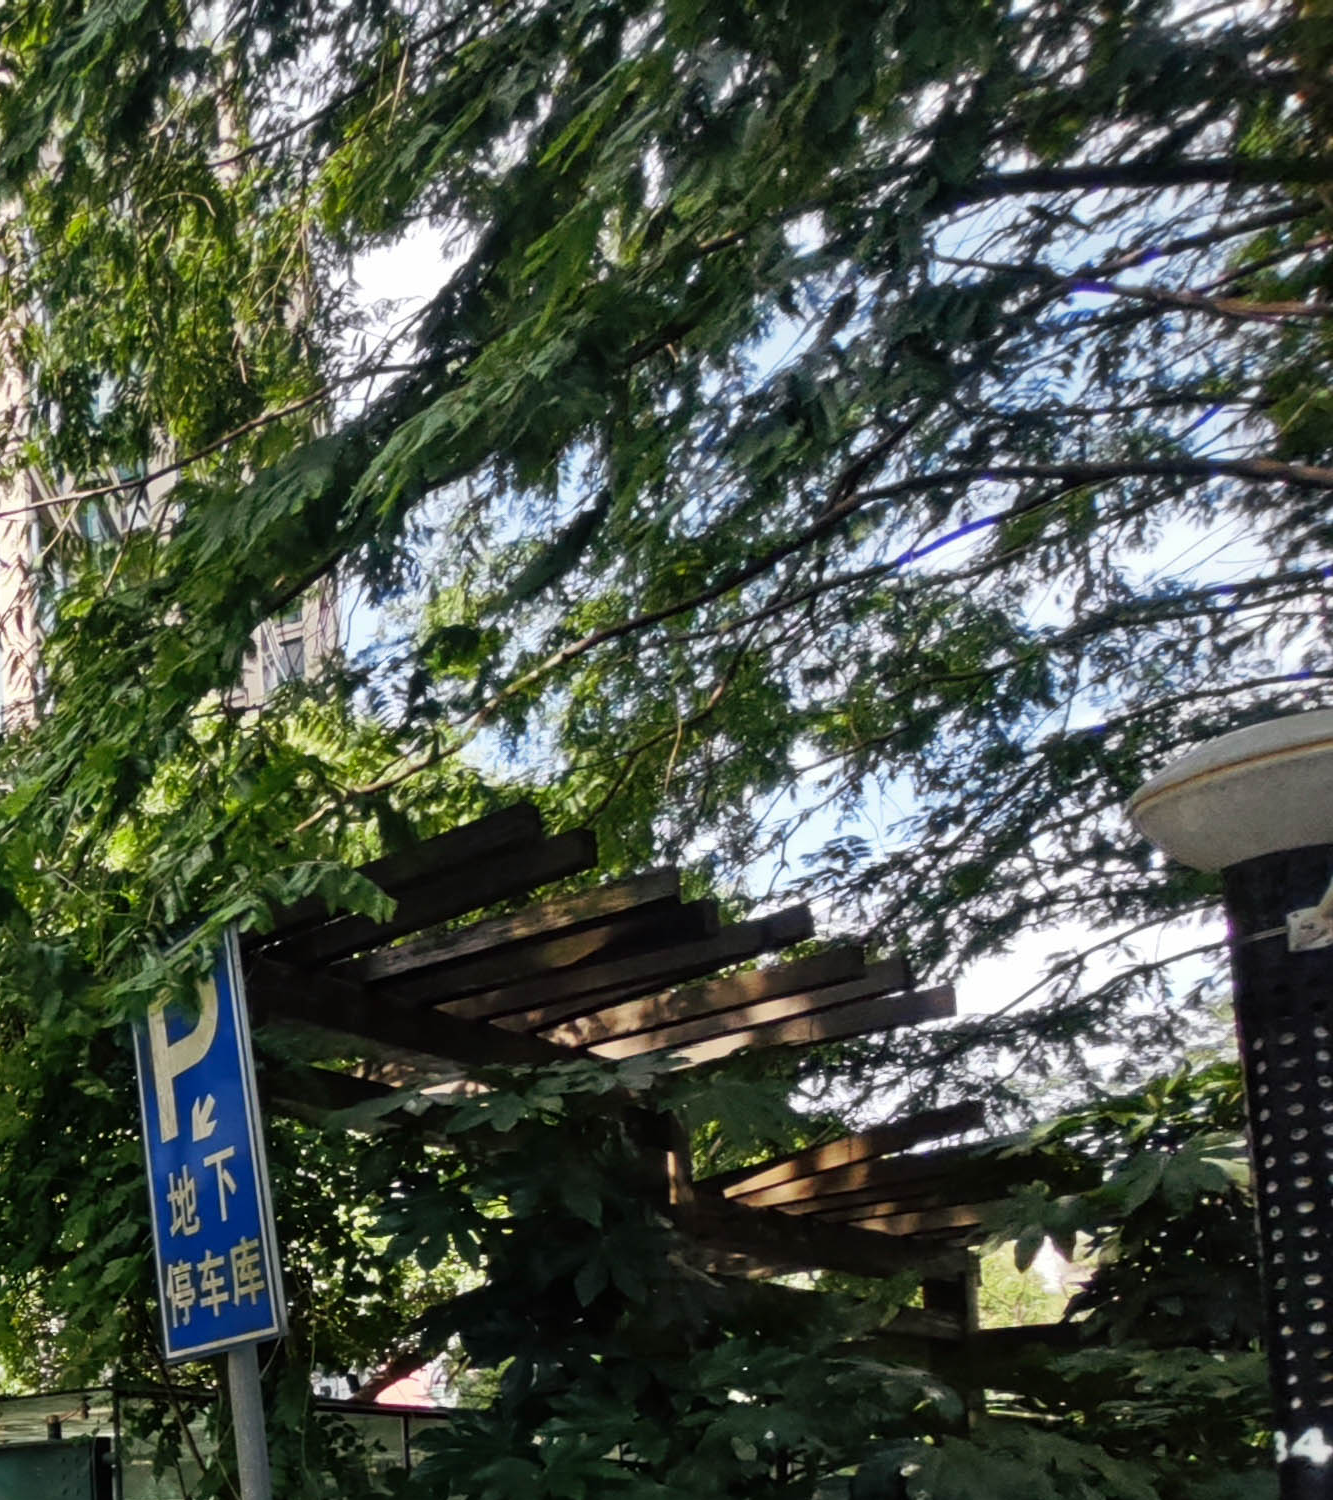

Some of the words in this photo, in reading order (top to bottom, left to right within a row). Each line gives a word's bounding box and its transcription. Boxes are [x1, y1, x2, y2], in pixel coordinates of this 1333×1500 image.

[147, 972, 219, 1143] P
[167, 1145, 237, 1238] 地下
[166, 1237, 265, 1328] 停车库
